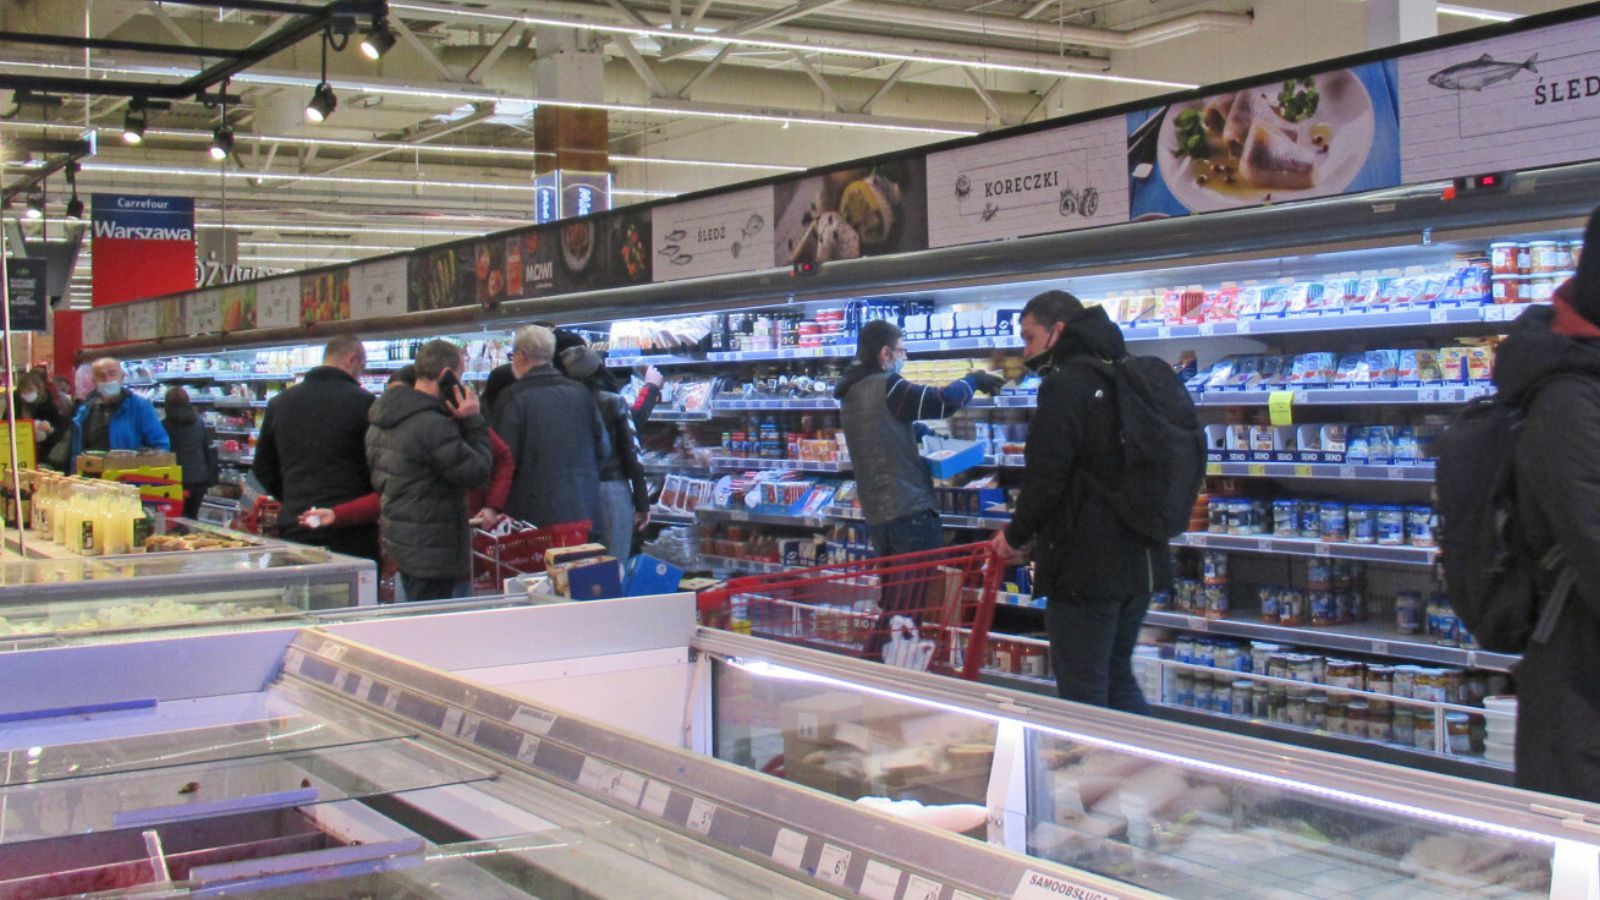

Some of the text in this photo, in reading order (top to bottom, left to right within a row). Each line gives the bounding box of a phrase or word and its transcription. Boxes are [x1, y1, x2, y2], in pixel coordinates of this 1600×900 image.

[984, 171, 1059, 197] KORECZKI
[117, 198, 169, 209] Carrefour
[94, 220, 192, 240] Warszawa
